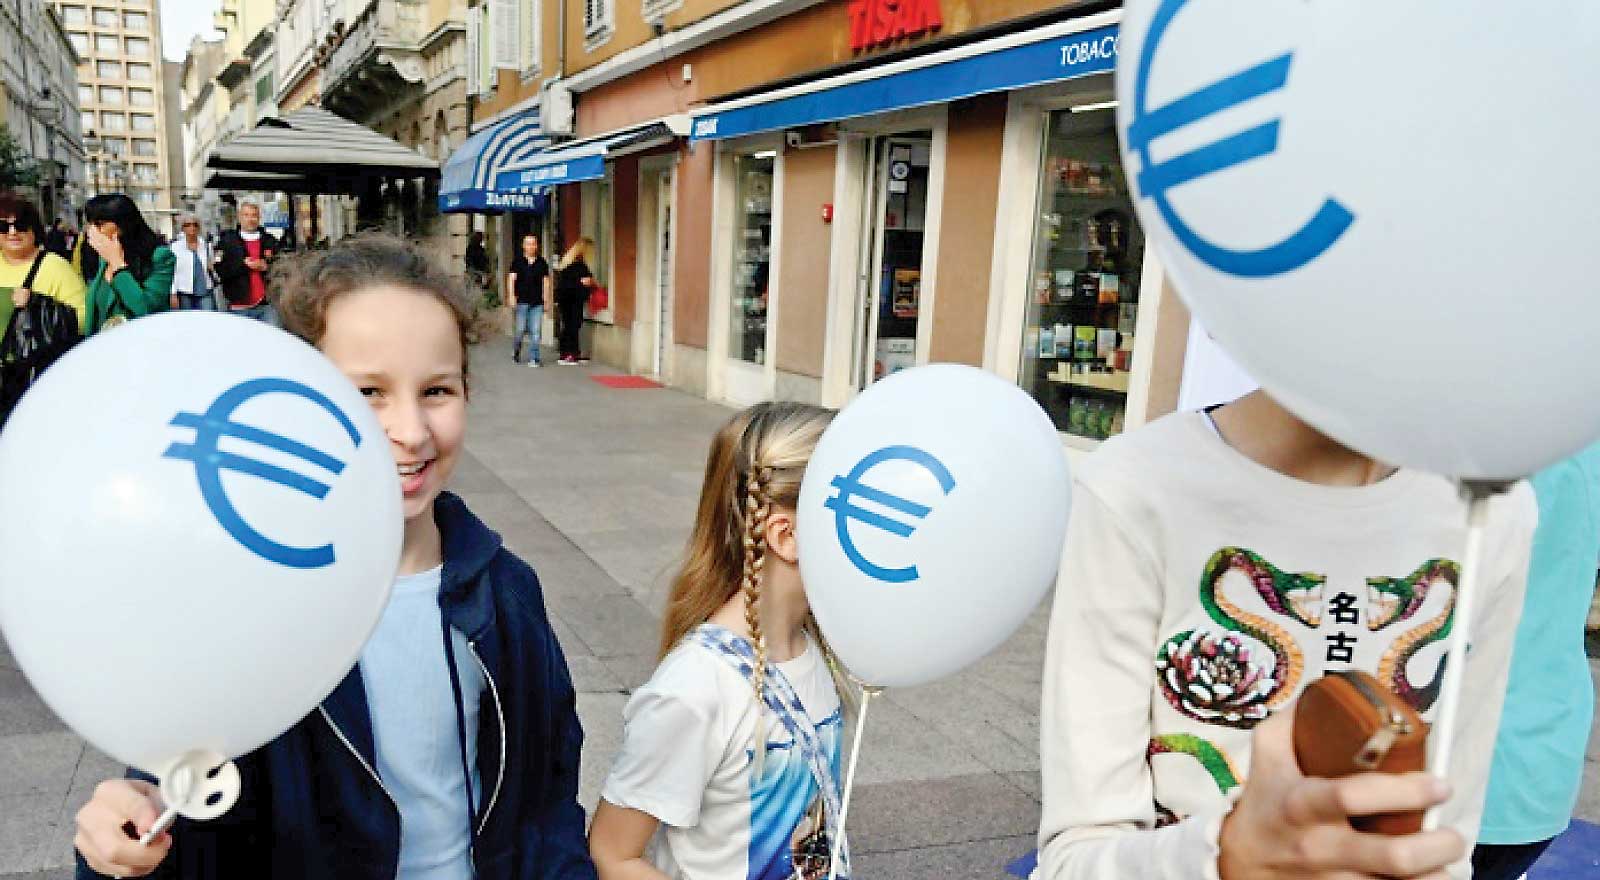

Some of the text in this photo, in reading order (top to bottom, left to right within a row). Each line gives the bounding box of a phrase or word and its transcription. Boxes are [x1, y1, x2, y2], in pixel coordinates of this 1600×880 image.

[161, 377, 362, 569] €
[824, 444, 956, 583] €
[1324, 592, 1360, 677] 名古
